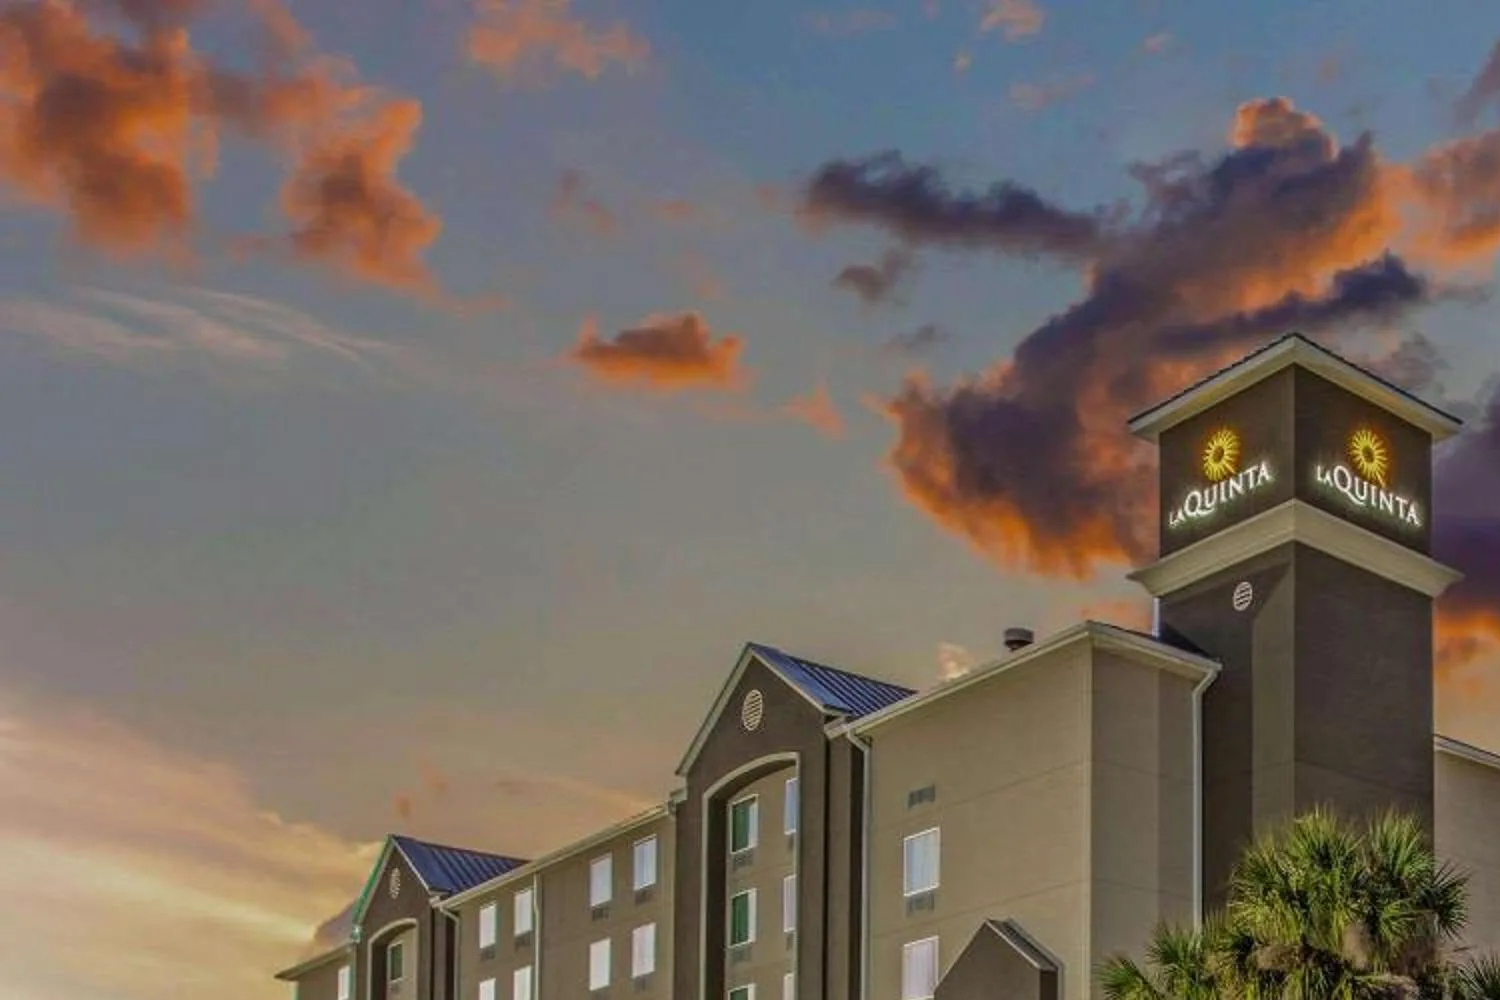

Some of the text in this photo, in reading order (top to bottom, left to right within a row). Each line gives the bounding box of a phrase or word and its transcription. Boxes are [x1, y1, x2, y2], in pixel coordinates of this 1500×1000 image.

[1168, 461, 1273, 527] LA QUINTA
[1316, 464, 1422, 526] LA QUINTA
